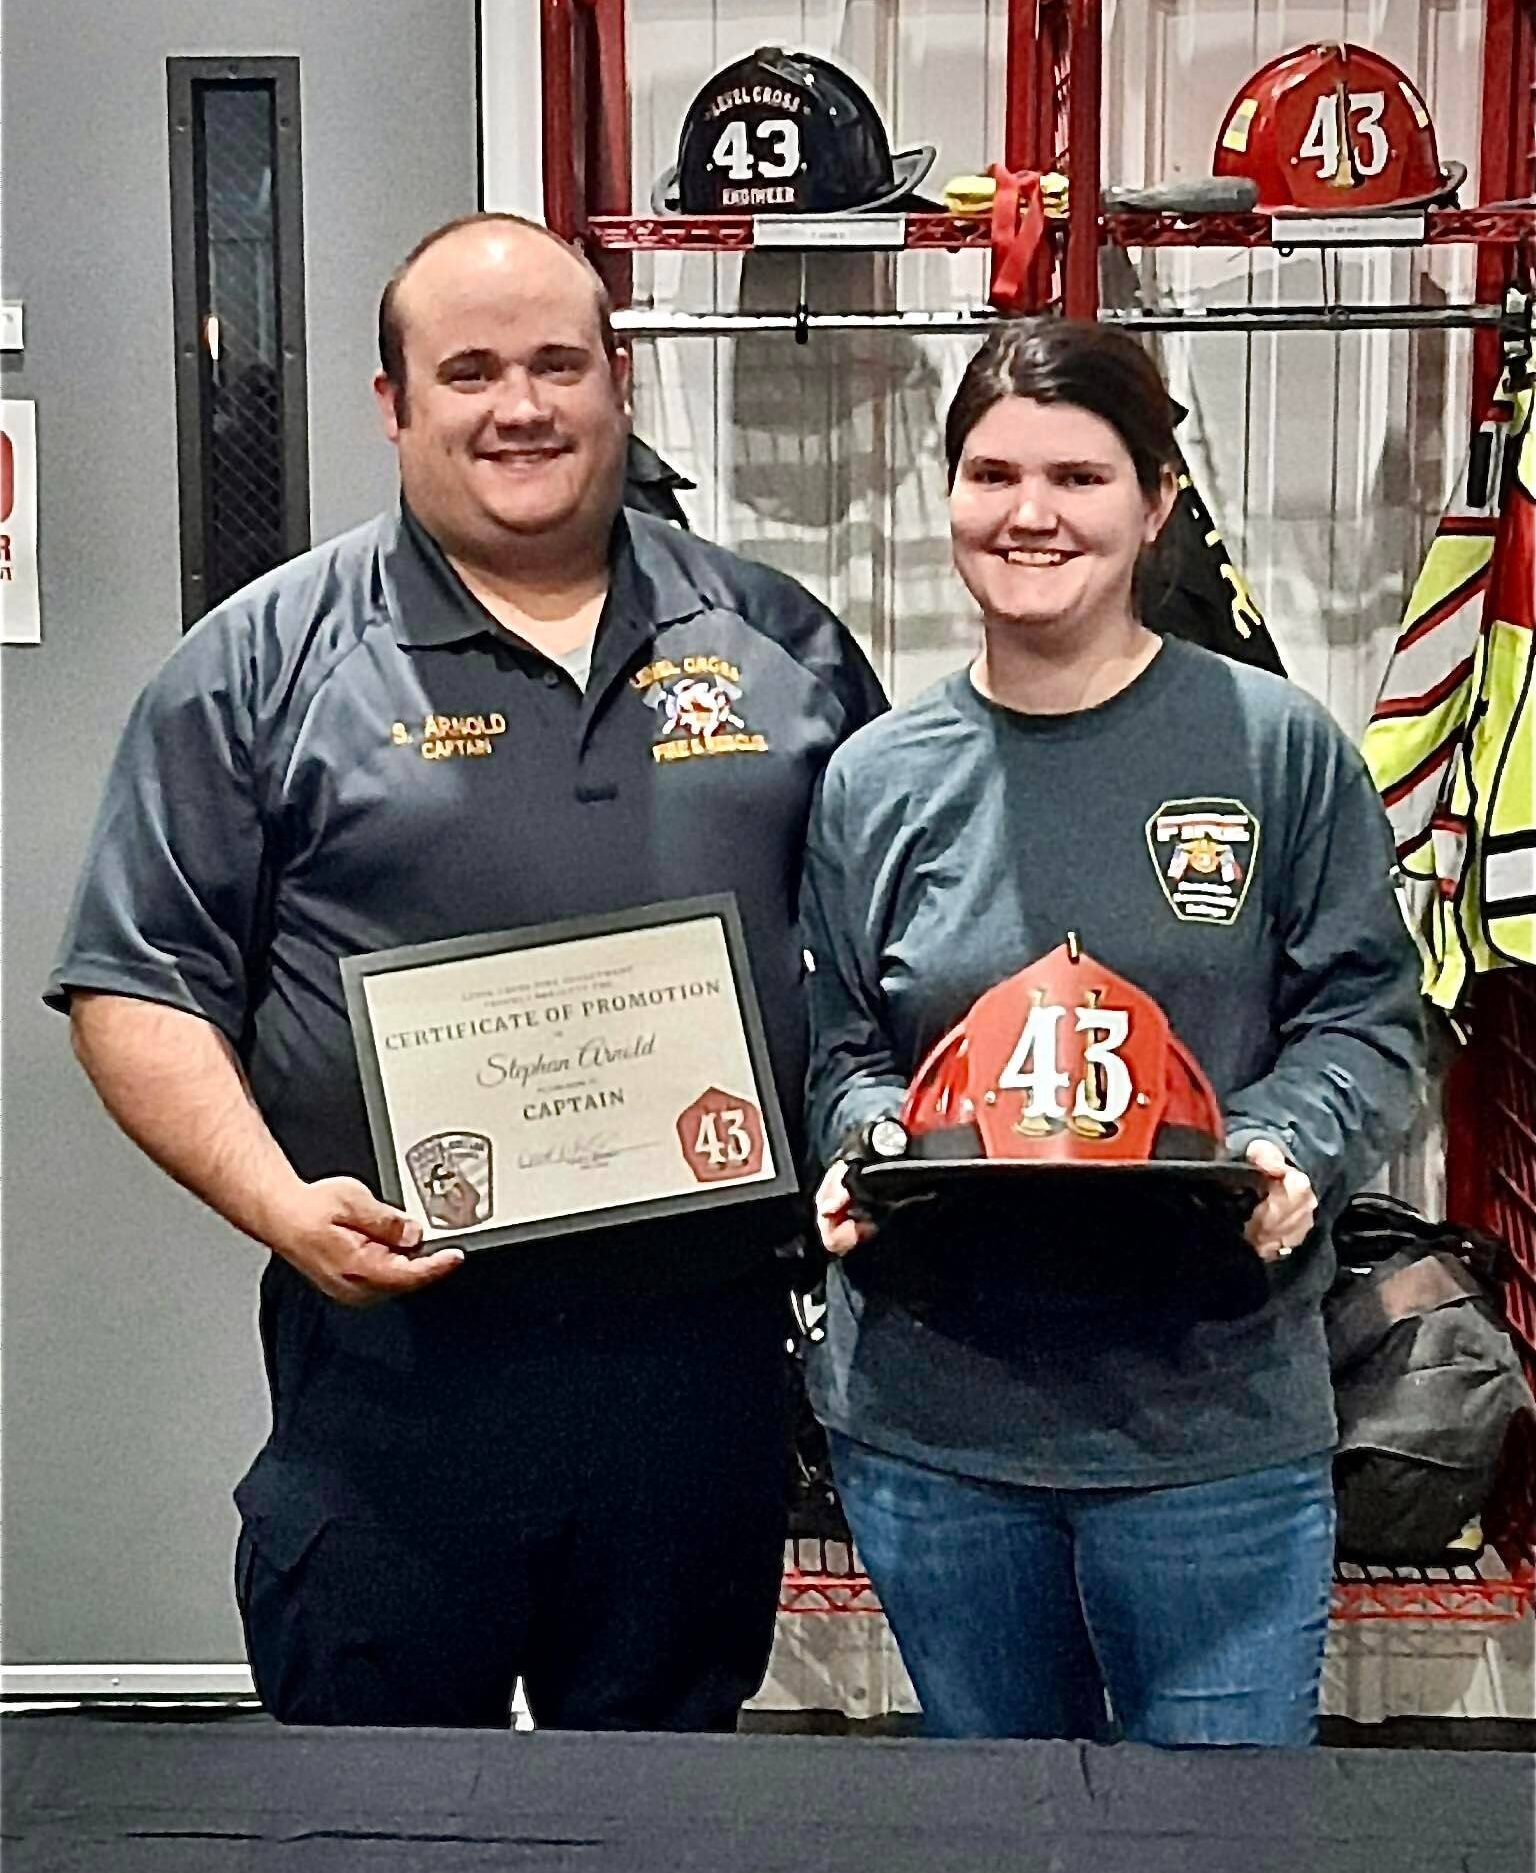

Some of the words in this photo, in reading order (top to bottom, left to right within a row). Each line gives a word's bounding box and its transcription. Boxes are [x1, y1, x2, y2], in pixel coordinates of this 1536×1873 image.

[752, 85, 801, 112] CROSS
[712, 119, 800, 179] 43
[1299, 92, 1388, 179] 43
[424, 713, 506, 738] ARNOLD
[385, 1008, 540, 1051] CERTIFICATE
[545, 1003, 575, 1023] OF
[583, 978, 722, 1018] PROMOTION
[475, 1052, 570, 1088] Stephan
[999, 1005, 1133, 1123] 43
[523, 1087, 625, 1121] CAPTAIN
[694, 1108, 752, 1166] 43
